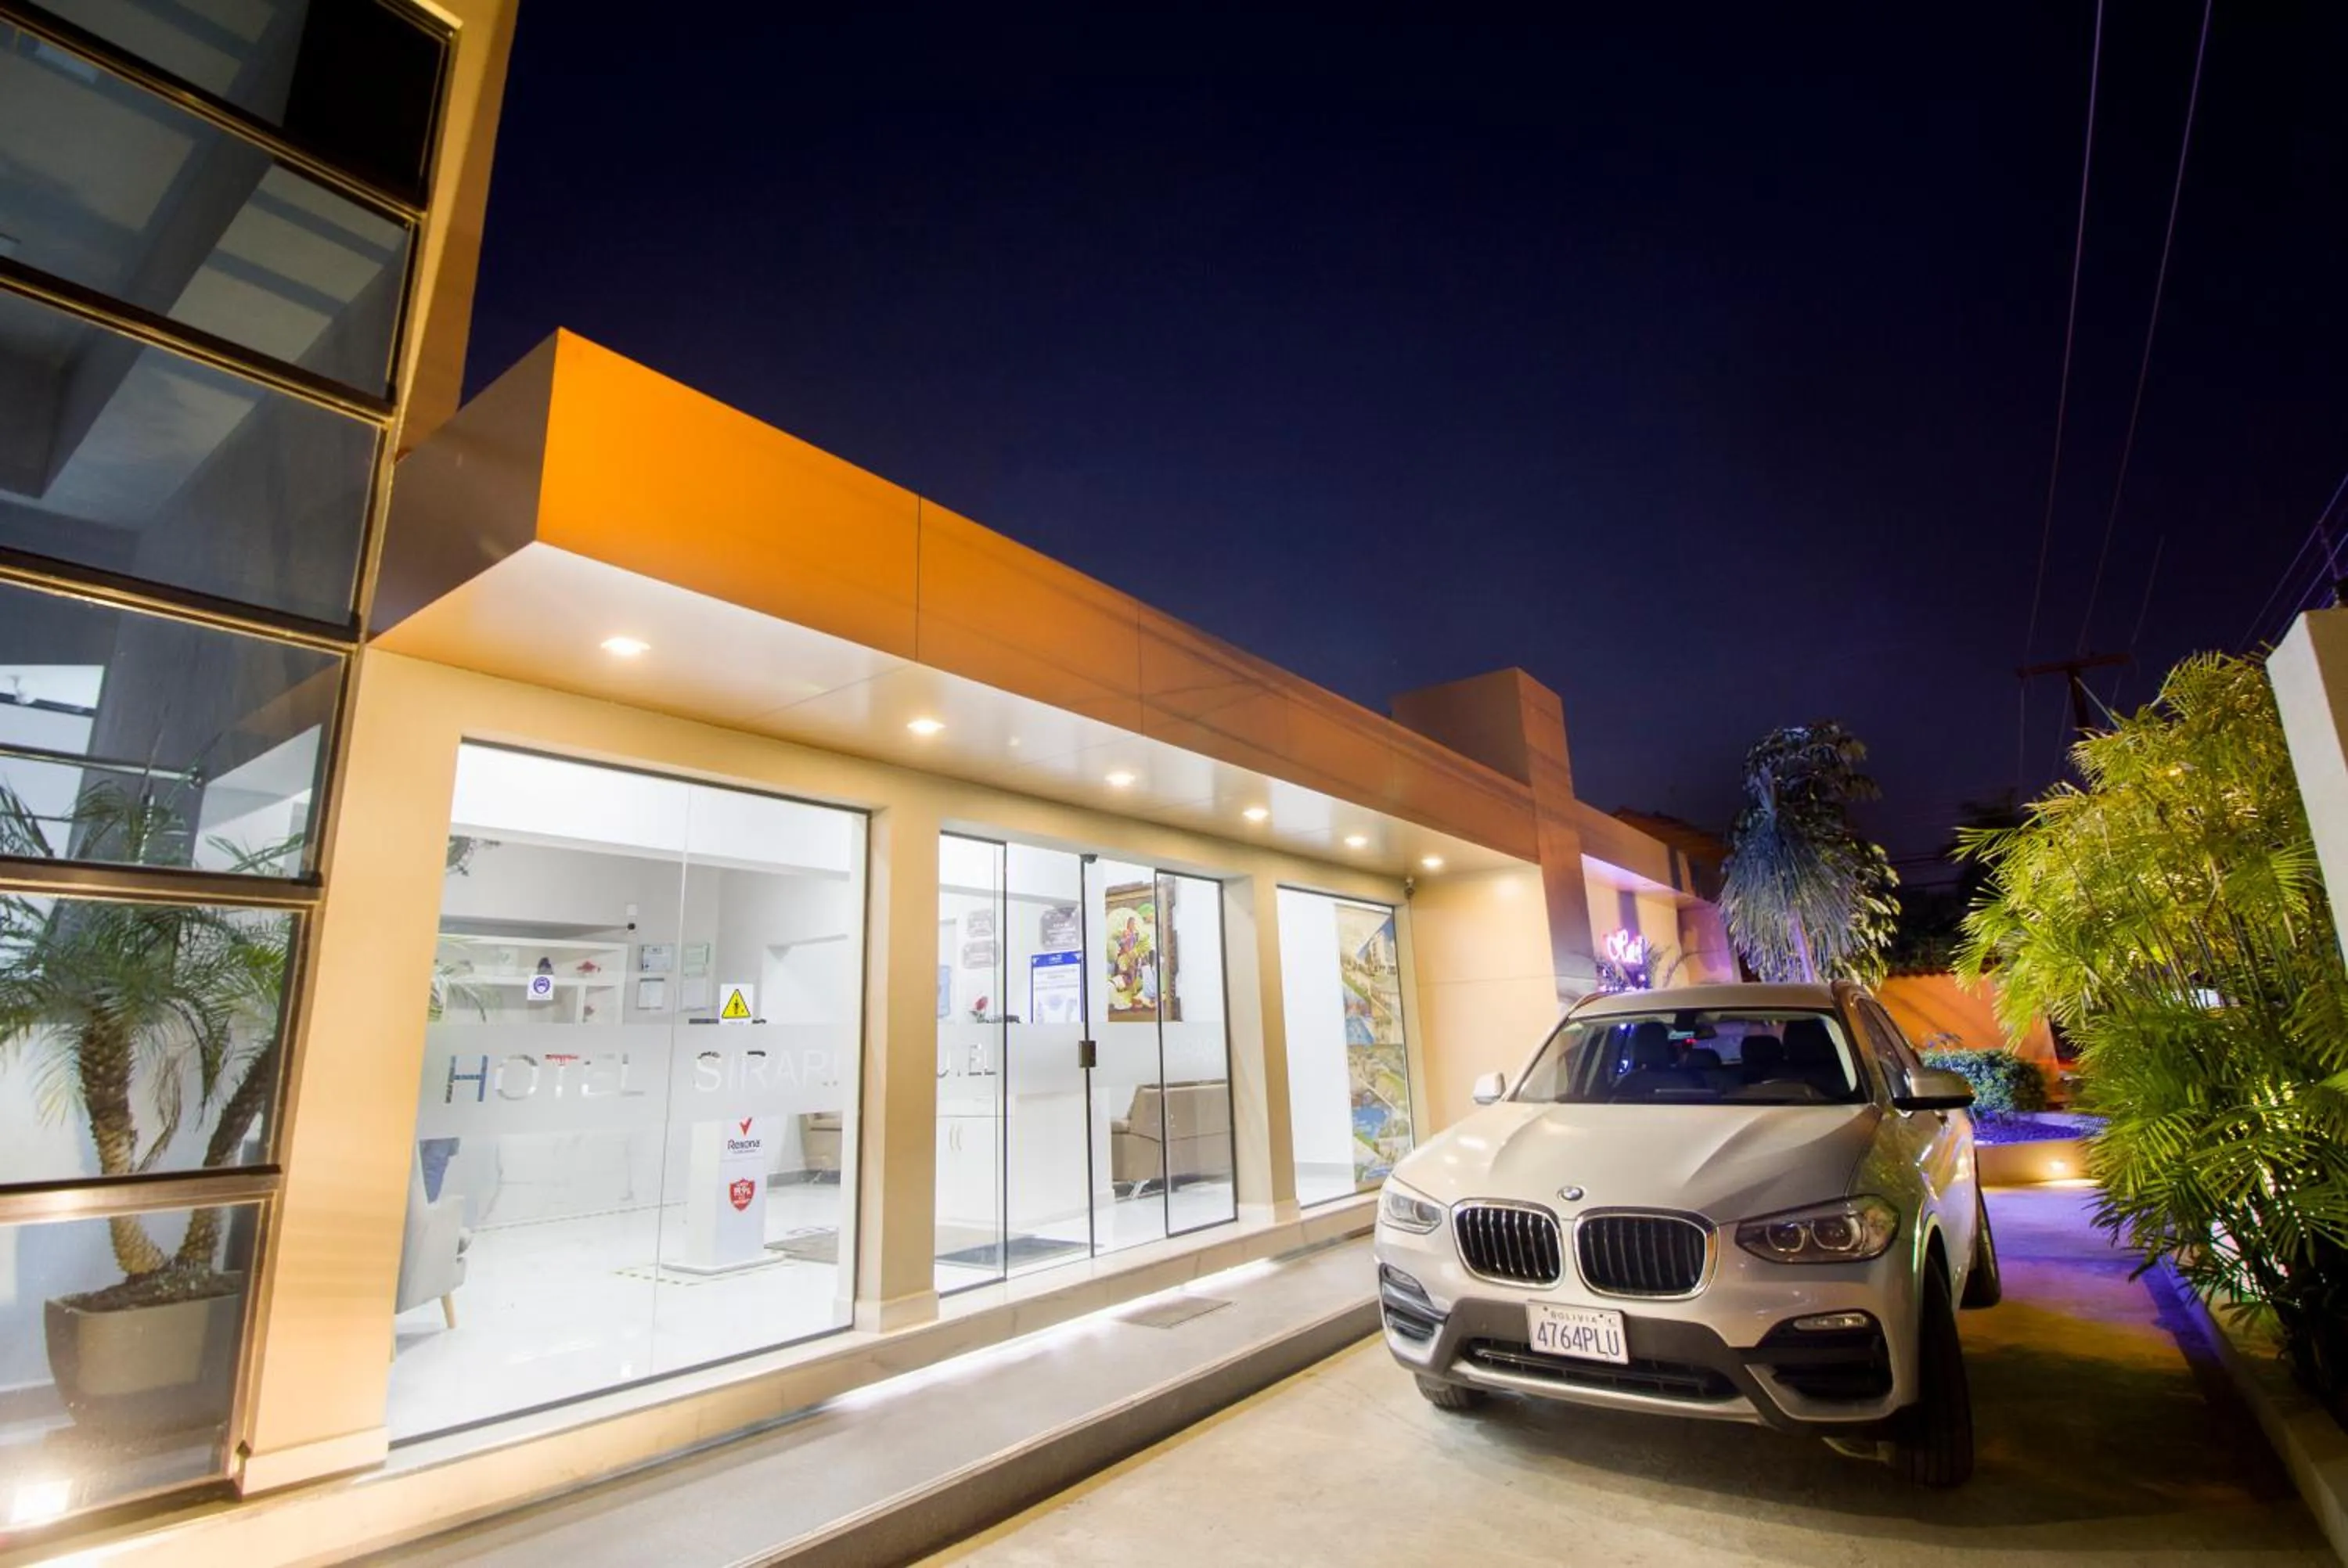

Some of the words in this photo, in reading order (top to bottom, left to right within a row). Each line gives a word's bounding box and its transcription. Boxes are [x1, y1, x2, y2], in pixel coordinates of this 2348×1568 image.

[444, 1053, 645, 1104] HOTEL
[1550, 1310, 1597, 1324] BOLIVIA
[1537, 1321, 1620, 1357] 4764PLU
